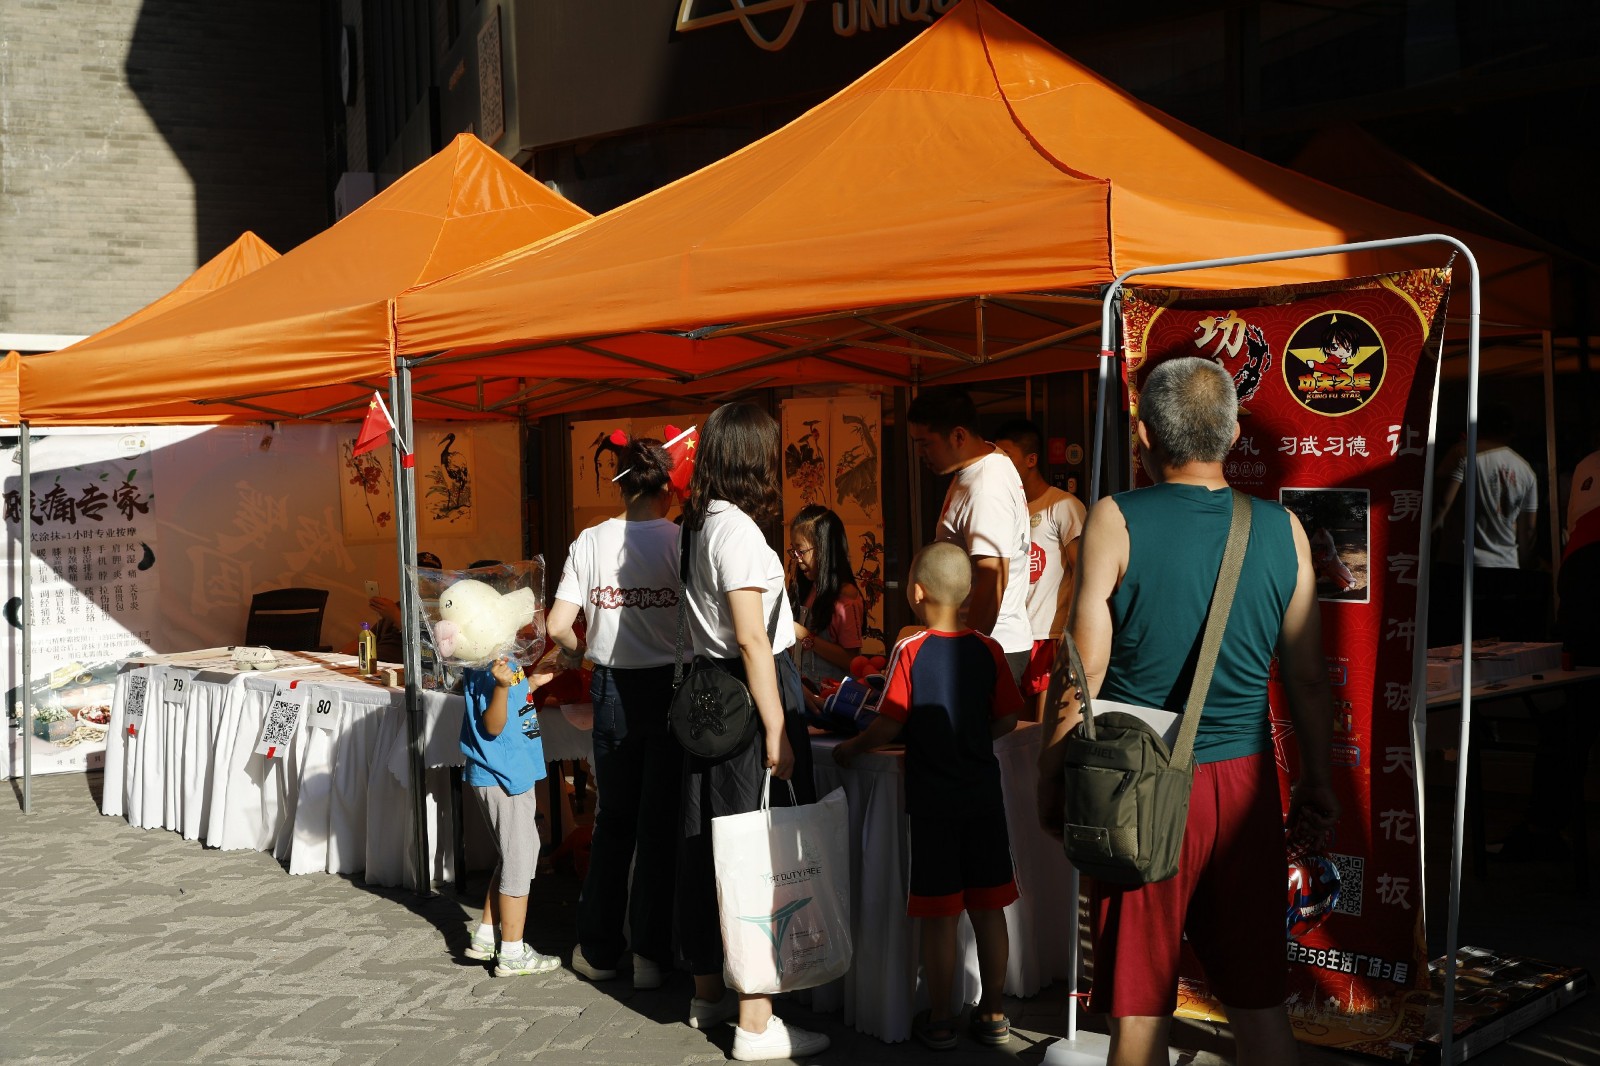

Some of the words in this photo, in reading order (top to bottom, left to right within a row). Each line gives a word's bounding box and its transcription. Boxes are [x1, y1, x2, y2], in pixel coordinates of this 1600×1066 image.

[1194, 310, 1247, 358] 功
[1298, 372, 1371, 392] 功夫之星
[1229, 436, 1260, 456] 礼
[1278, 435, 1370, 457] 习武习德
[1224, 461, 1267, 478] 教品牌
[173, 678, 184, 692] 79
[316, 699, 331, 714] 80
[1286, 941, 1409, 985] 店258生活广场3层
